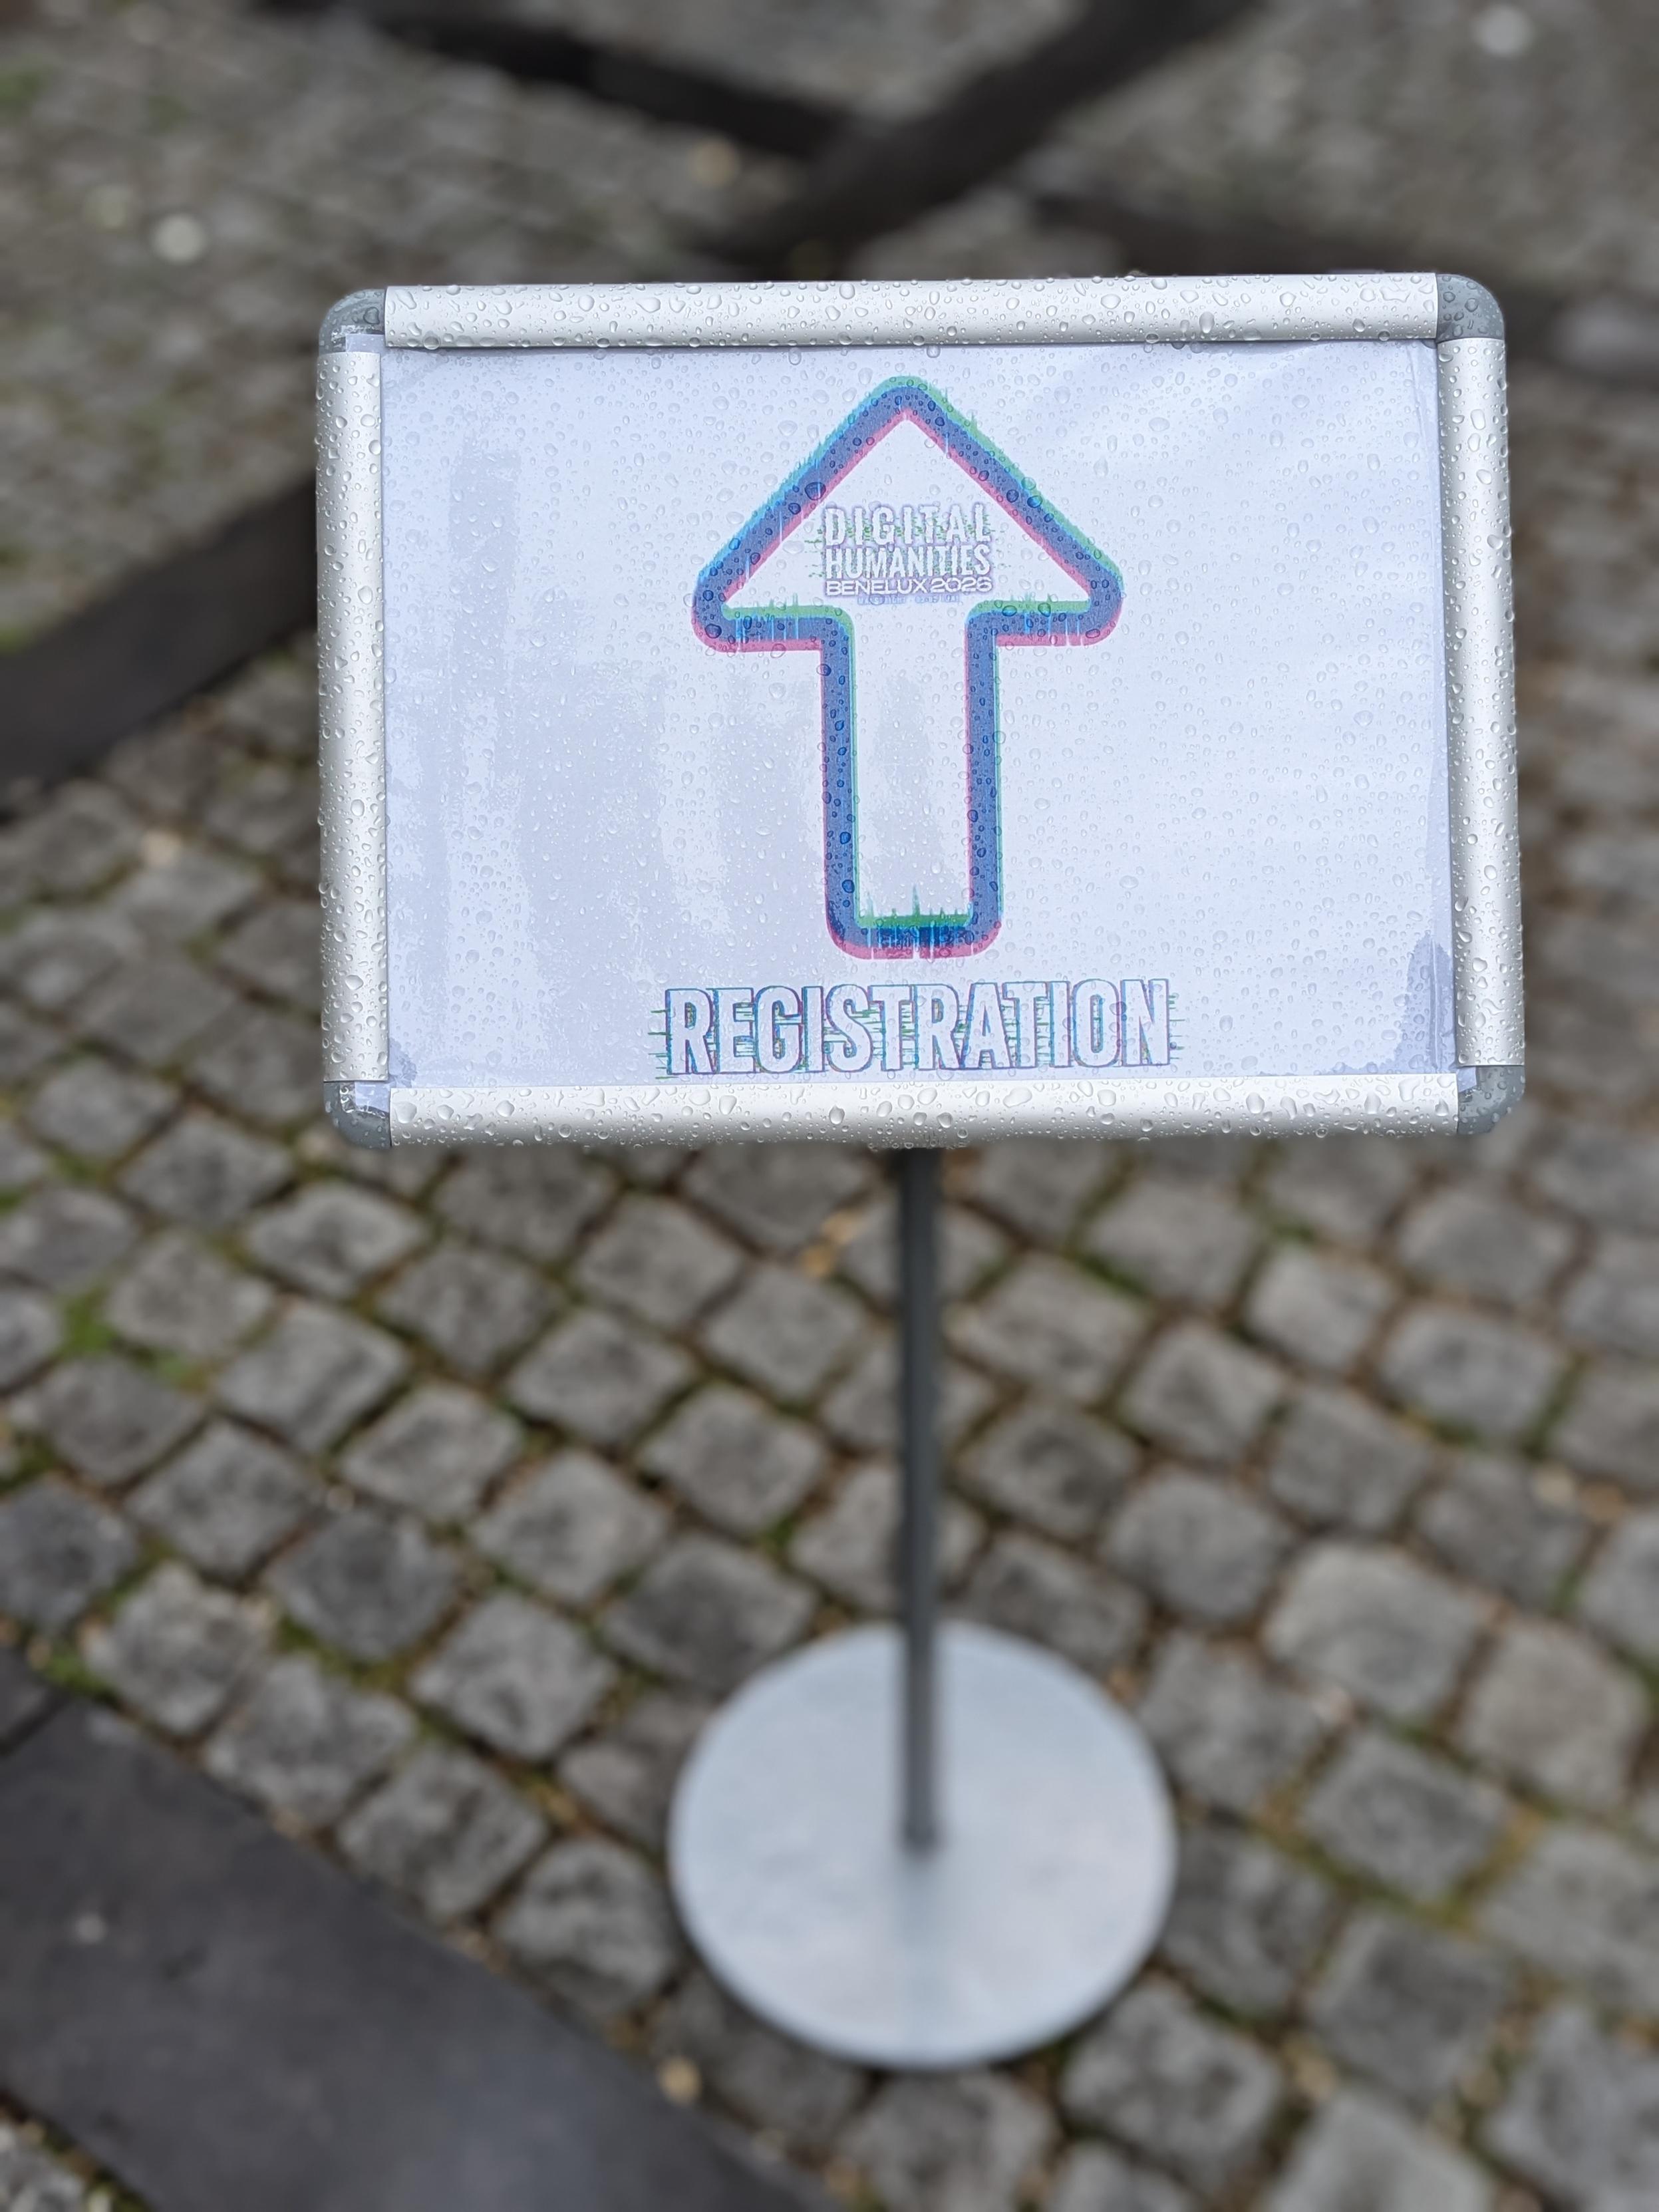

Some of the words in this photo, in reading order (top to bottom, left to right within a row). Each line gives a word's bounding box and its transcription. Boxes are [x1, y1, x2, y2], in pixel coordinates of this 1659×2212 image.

[824, 503, 992, 546] DIGITAL
[824, 544, 991, 579] HUMANITIES
[825, 577, 927, 596] BENELUX
[929, 576, 993, 593] 2026
[665, 978, 1171, 1075] REGISTRATION
